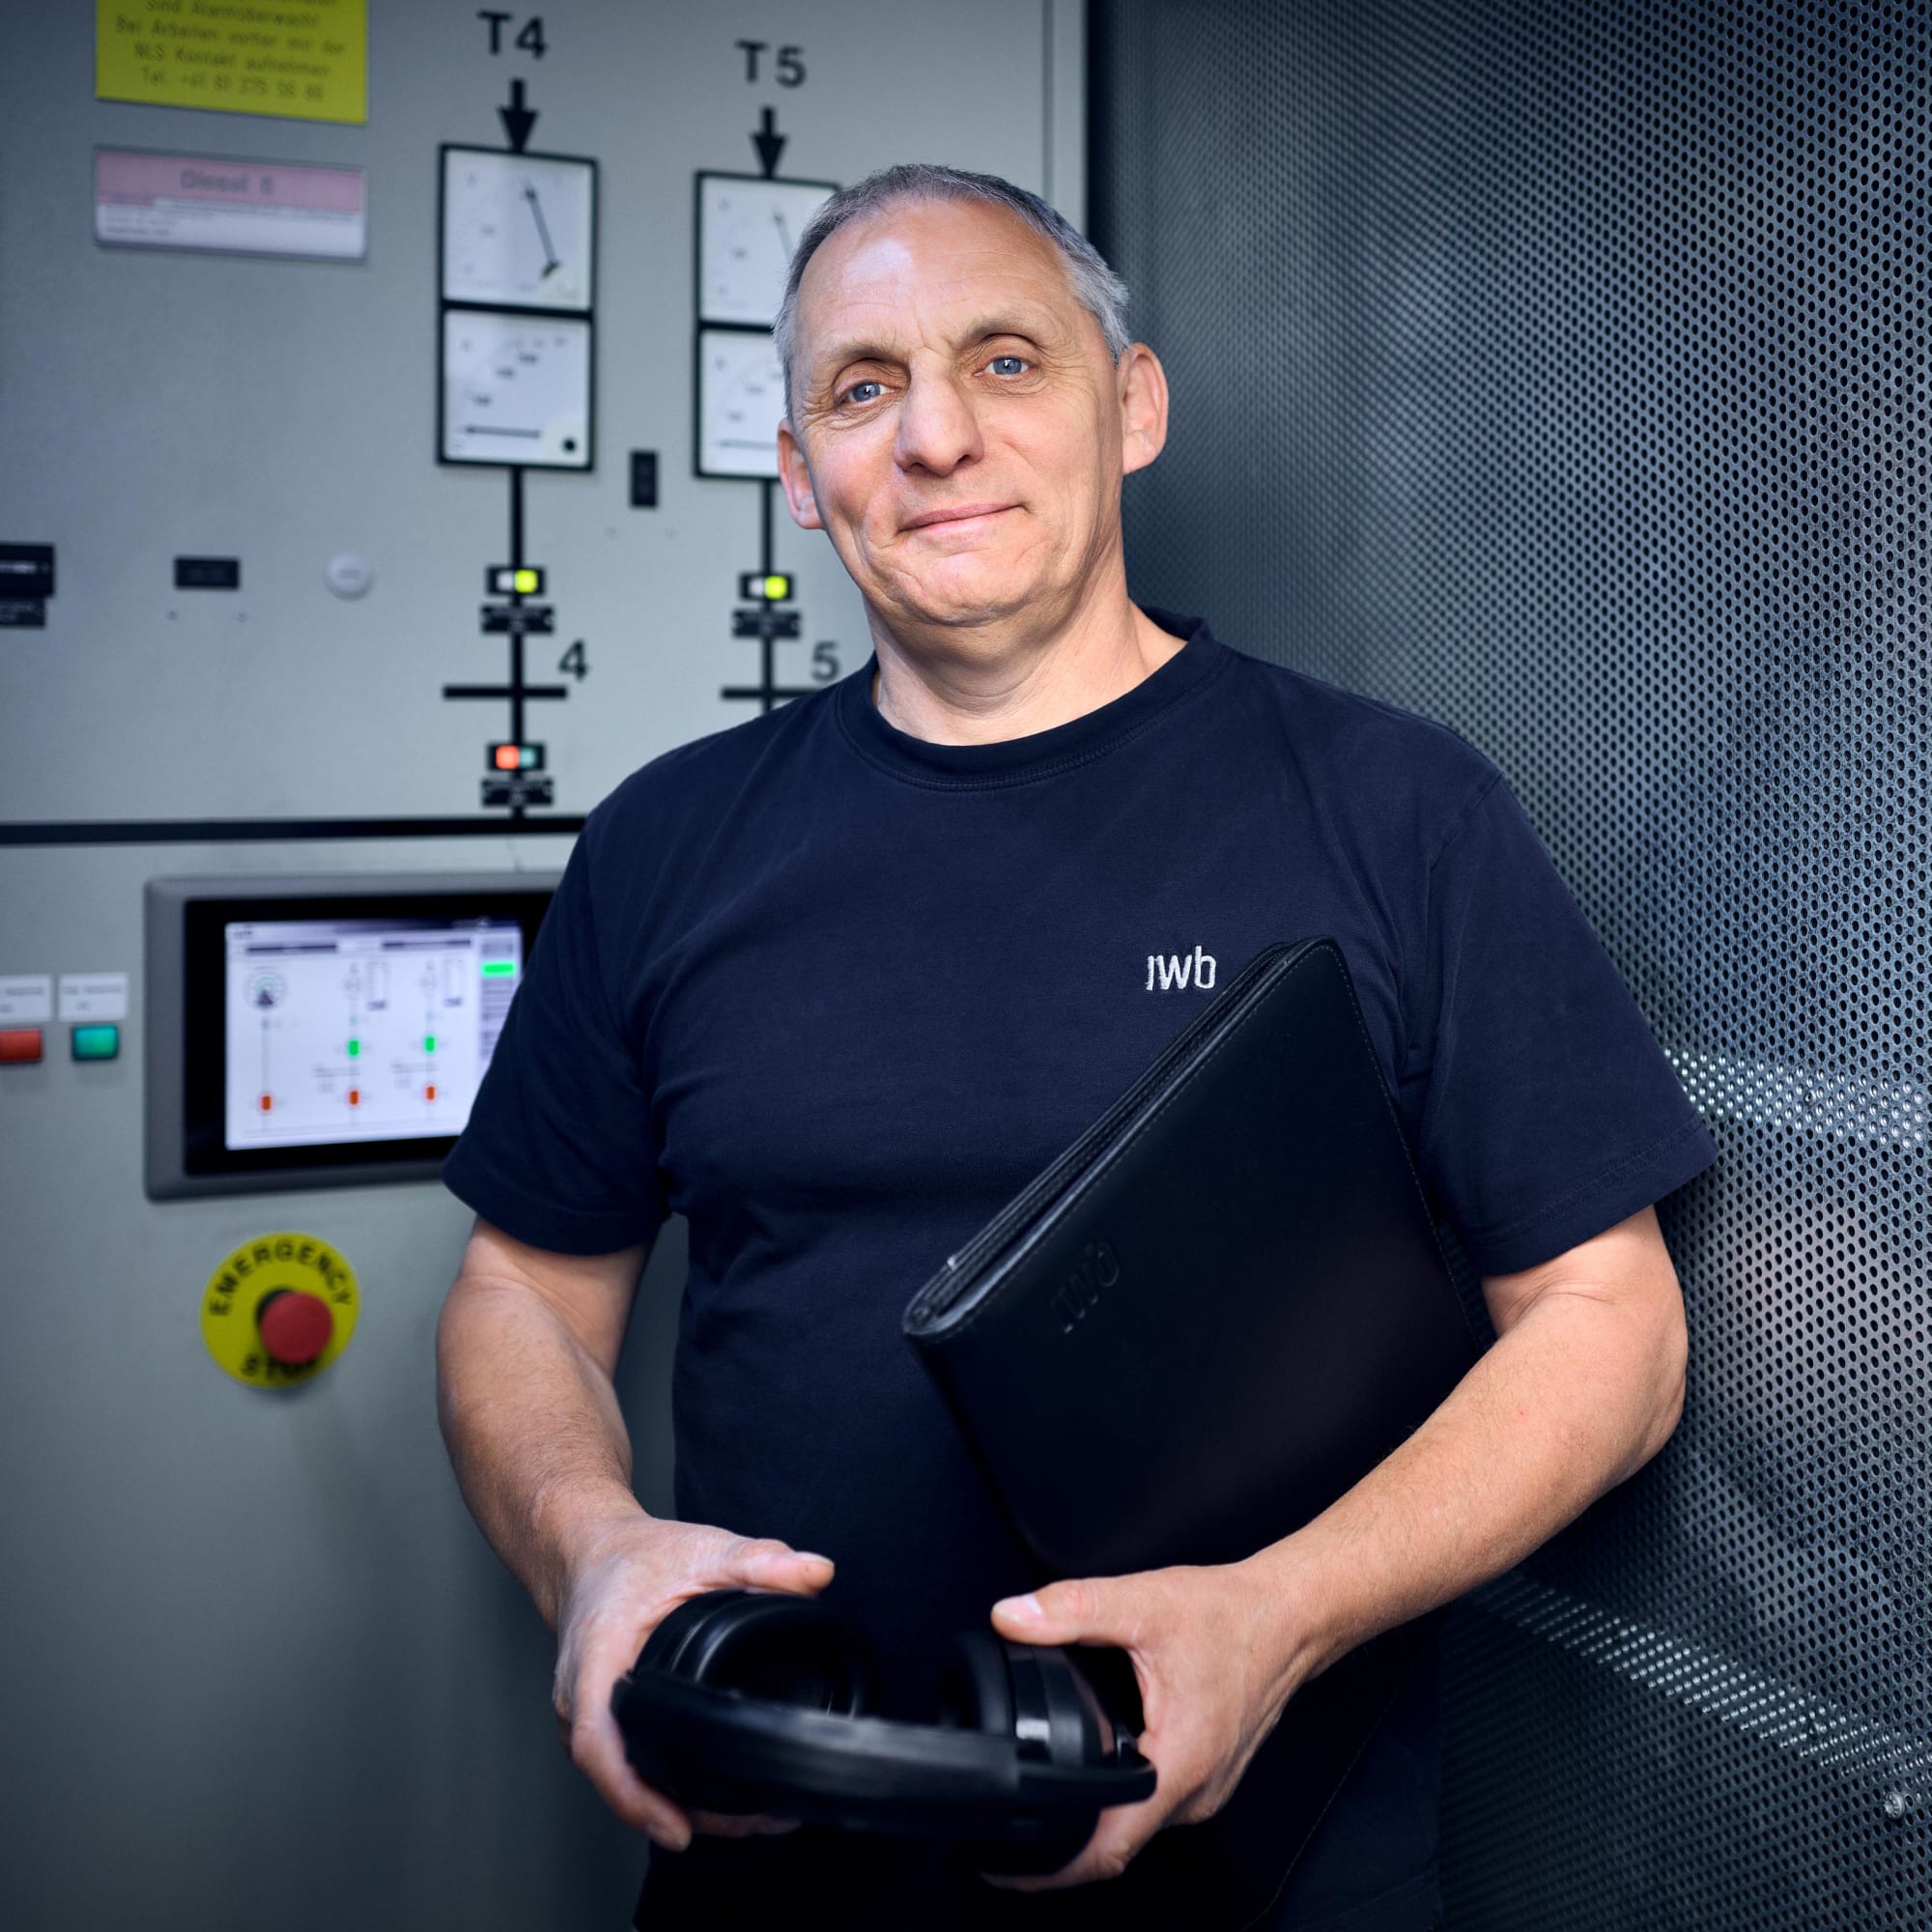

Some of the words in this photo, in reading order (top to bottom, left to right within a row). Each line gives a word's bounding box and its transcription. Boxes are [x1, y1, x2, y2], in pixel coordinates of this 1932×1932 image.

[151, 19, 218, 42] Arbeiten
[477, 10, 549, 60] T4
[174, 45, 235, 68] Kontakt
[735, 40, 806, 88] T5
[180, 167, 250, 194] Diesel
[557, 639, 588, 681] 4
[811, 641, 839, 682] 5
[209, 1238, 352, 1317] EMERGENCY
